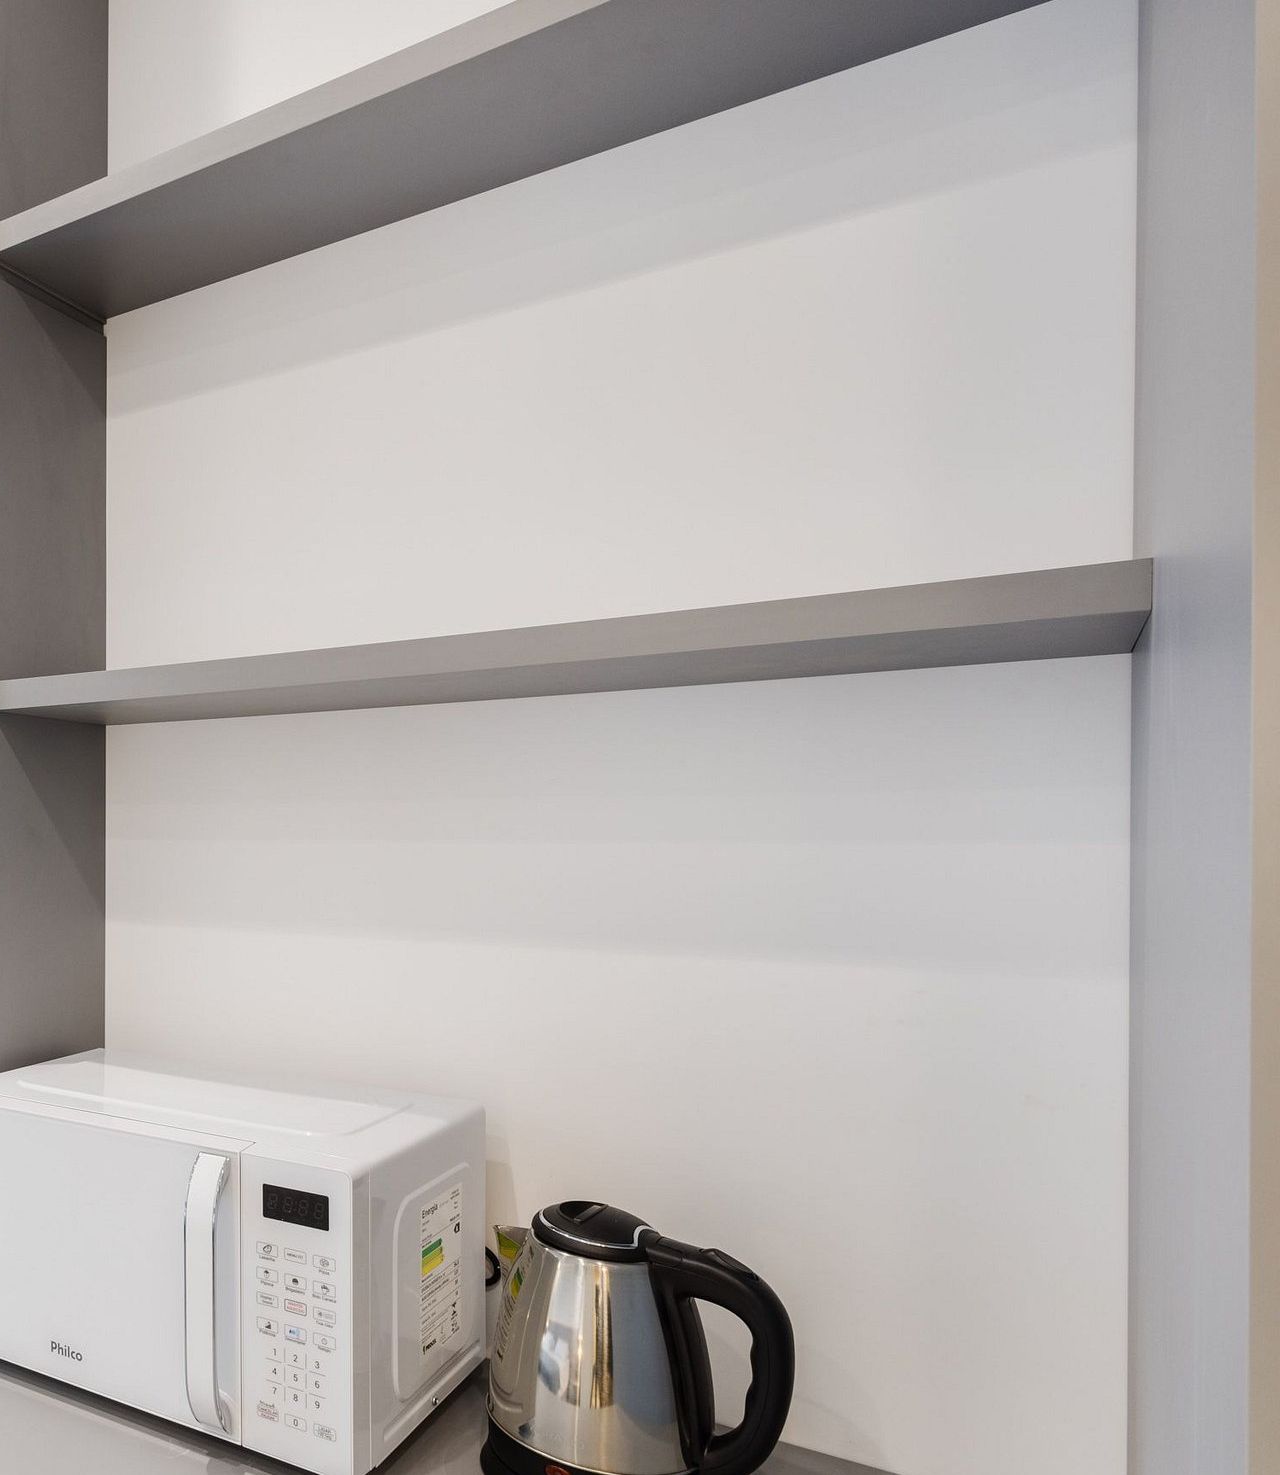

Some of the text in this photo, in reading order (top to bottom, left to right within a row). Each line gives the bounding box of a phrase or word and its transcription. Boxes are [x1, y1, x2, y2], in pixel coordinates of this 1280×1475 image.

[50, 1340, 83, 1361] Philco
[273, 1348, 277, 1356] 1
[293, 1354, 298, 1363] 2
[314, 1361, 320, 1369] 3
[293, 1374, 298, 1382] 5
[314, 1380, 320, 1389] 6
[272, 1386, 277, 1394] 7
[293, 1393, 298, 1402] 8
[314, 1400, 320, 1409] 9
[293, 1418, 298, 1427] 0
